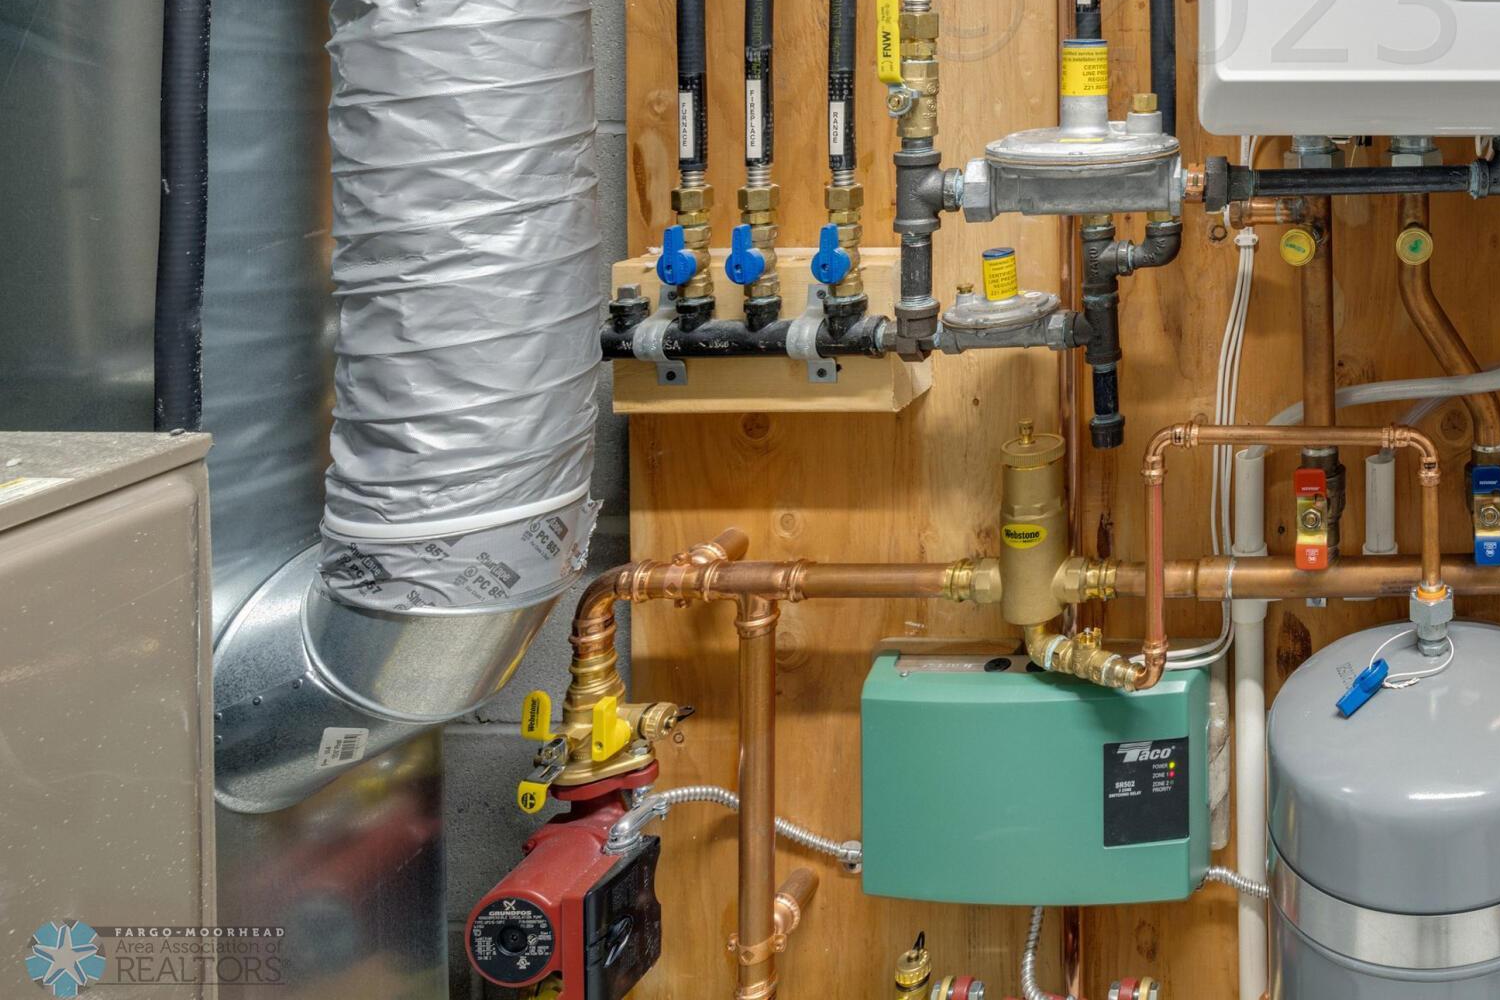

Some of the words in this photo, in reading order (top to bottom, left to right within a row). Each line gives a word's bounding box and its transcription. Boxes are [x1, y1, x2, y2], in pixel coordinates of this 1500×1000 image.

[883, 30, 892, 58] FNW
[535, 530, 549, 544] PC
[546, 542, 561, 557] 857
[349, 563, 365, 579] PC
[472, 575, 491, 591] PC
[527, 698, 537, 733] Webstone
[1116, 741, 1172, 763] Taco
